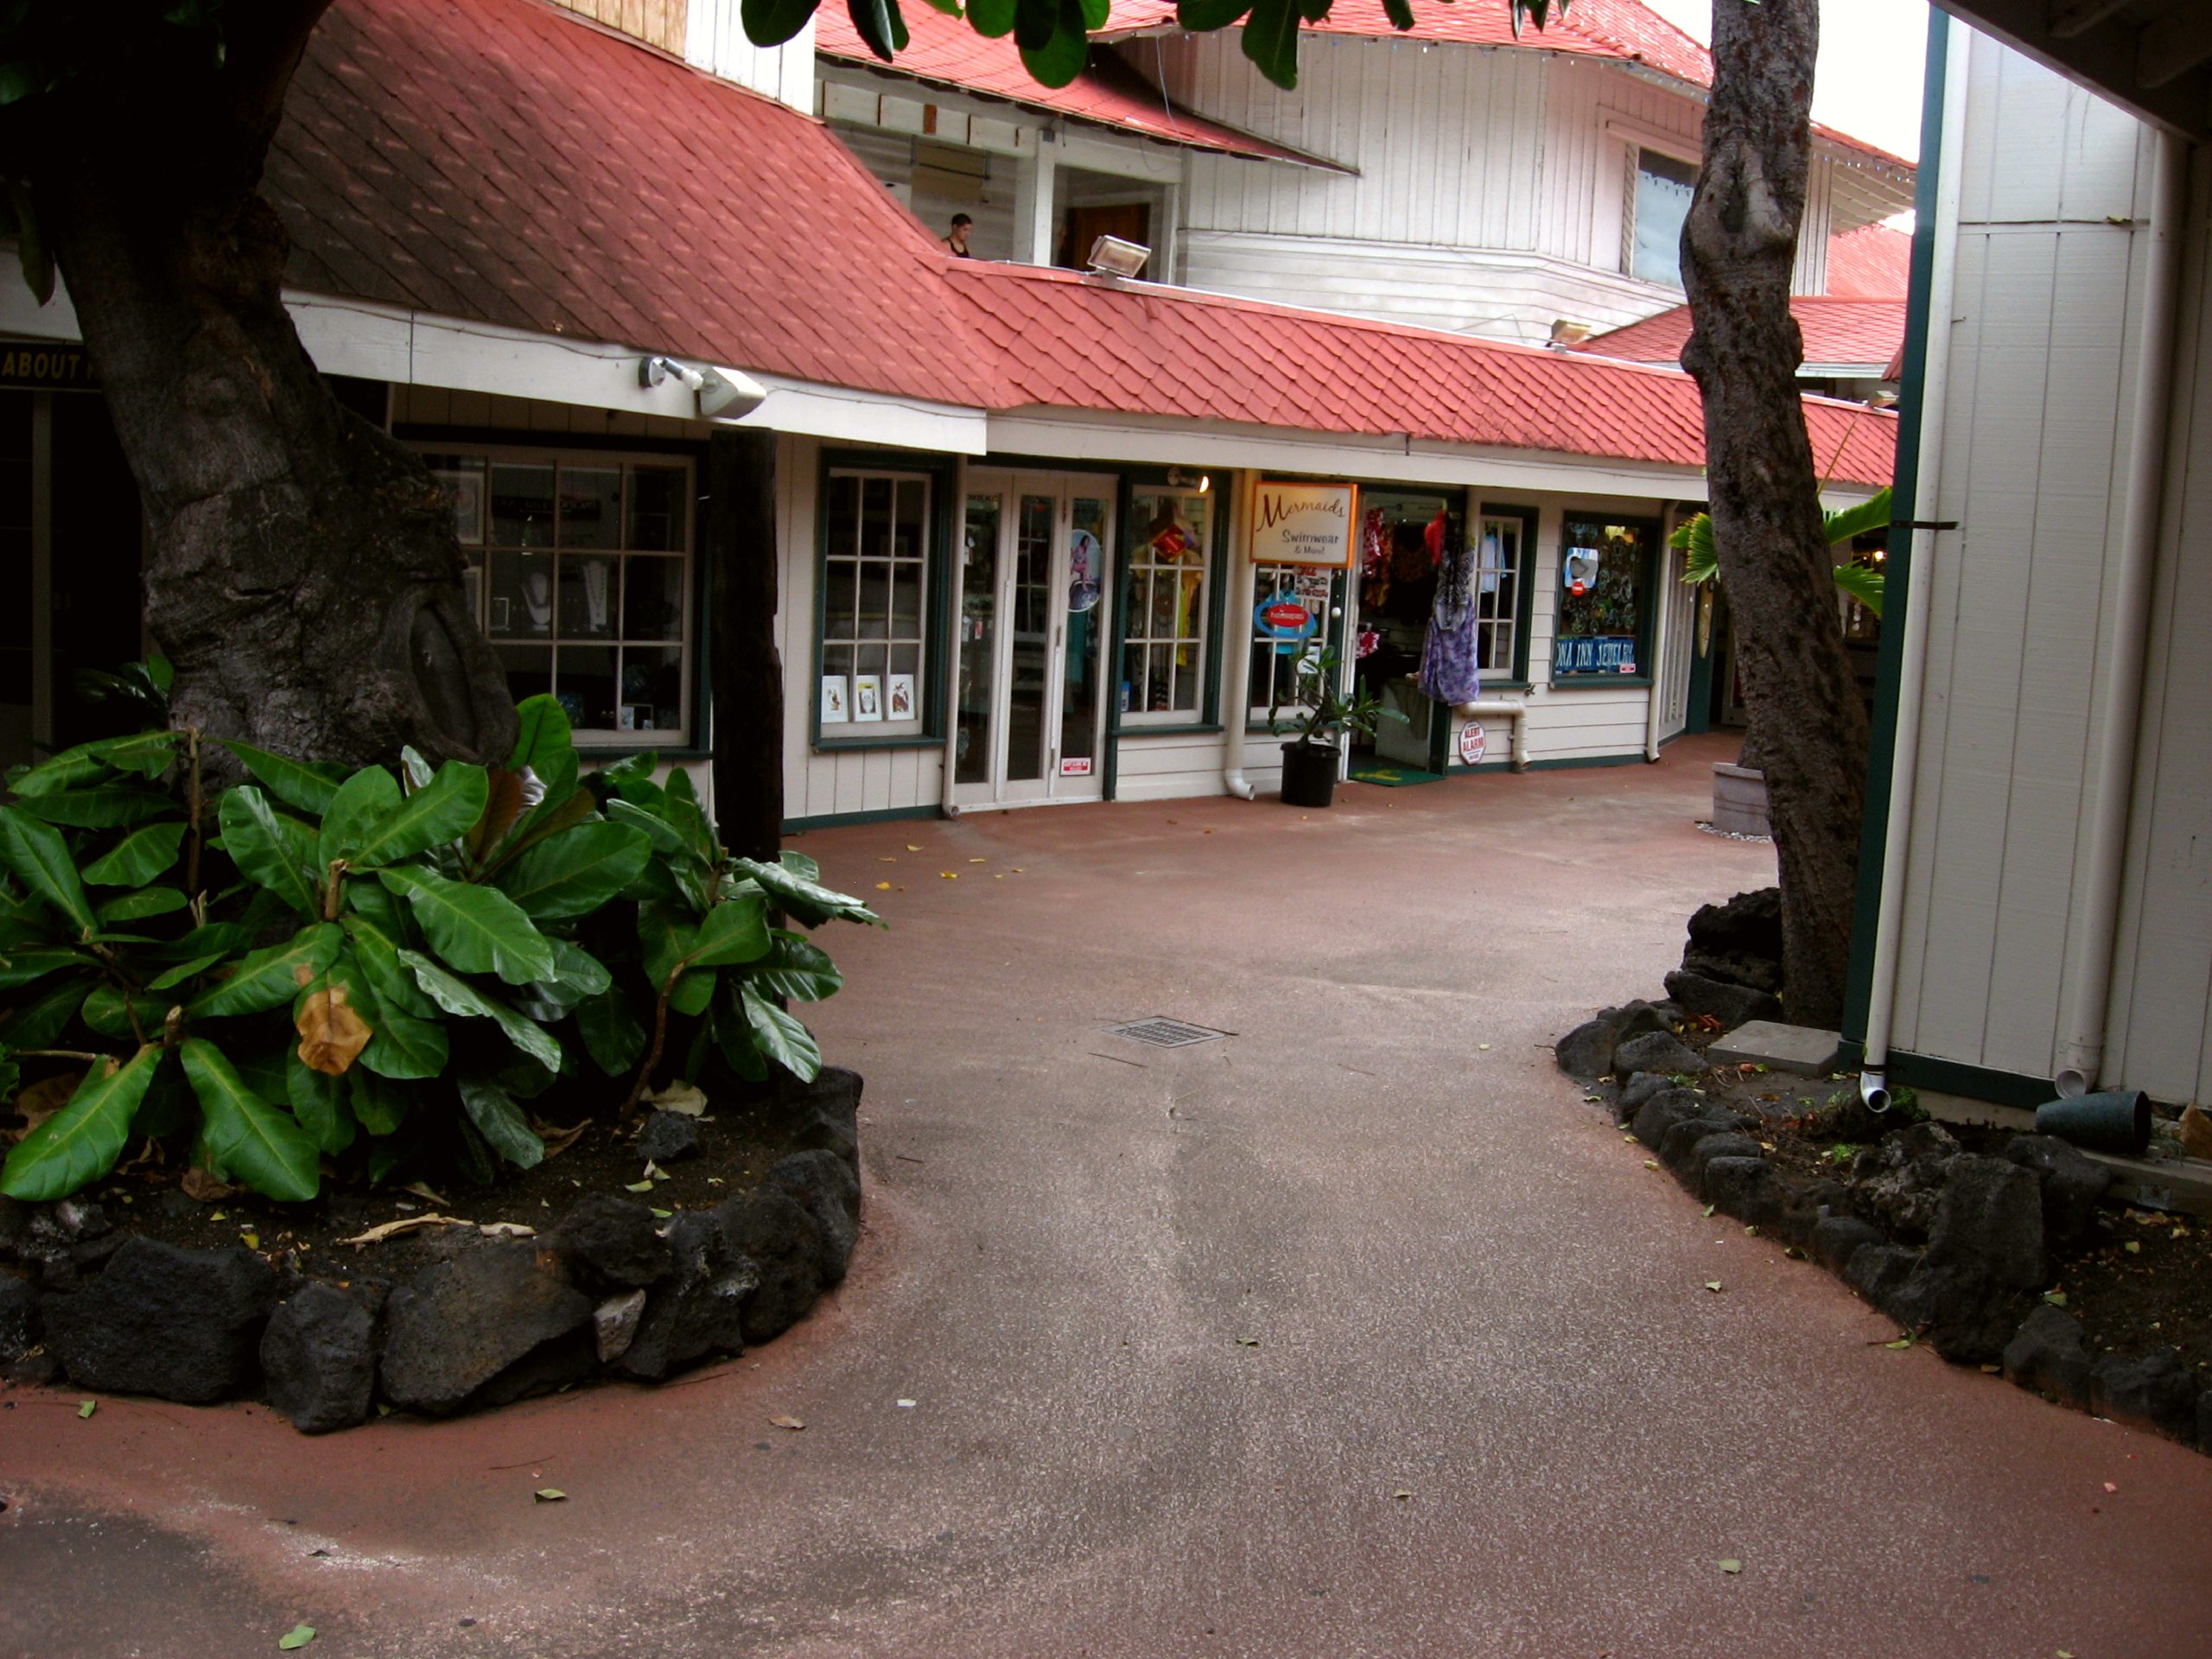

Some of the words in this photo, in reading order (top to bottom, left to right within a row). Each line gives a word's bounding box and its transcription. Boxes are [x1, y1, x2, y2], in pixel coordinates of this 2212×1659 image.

[1, 350, 81, 380] ABOUT
[1255, 493, 1345, 532] Mermaids
[1281, 529, 1339, 544] Swimwear
[1576, 643, 1593, 667] INN
[1465, 726, 1480, 739] ALERT
[1463, 736, 1484, 752] ALARM
